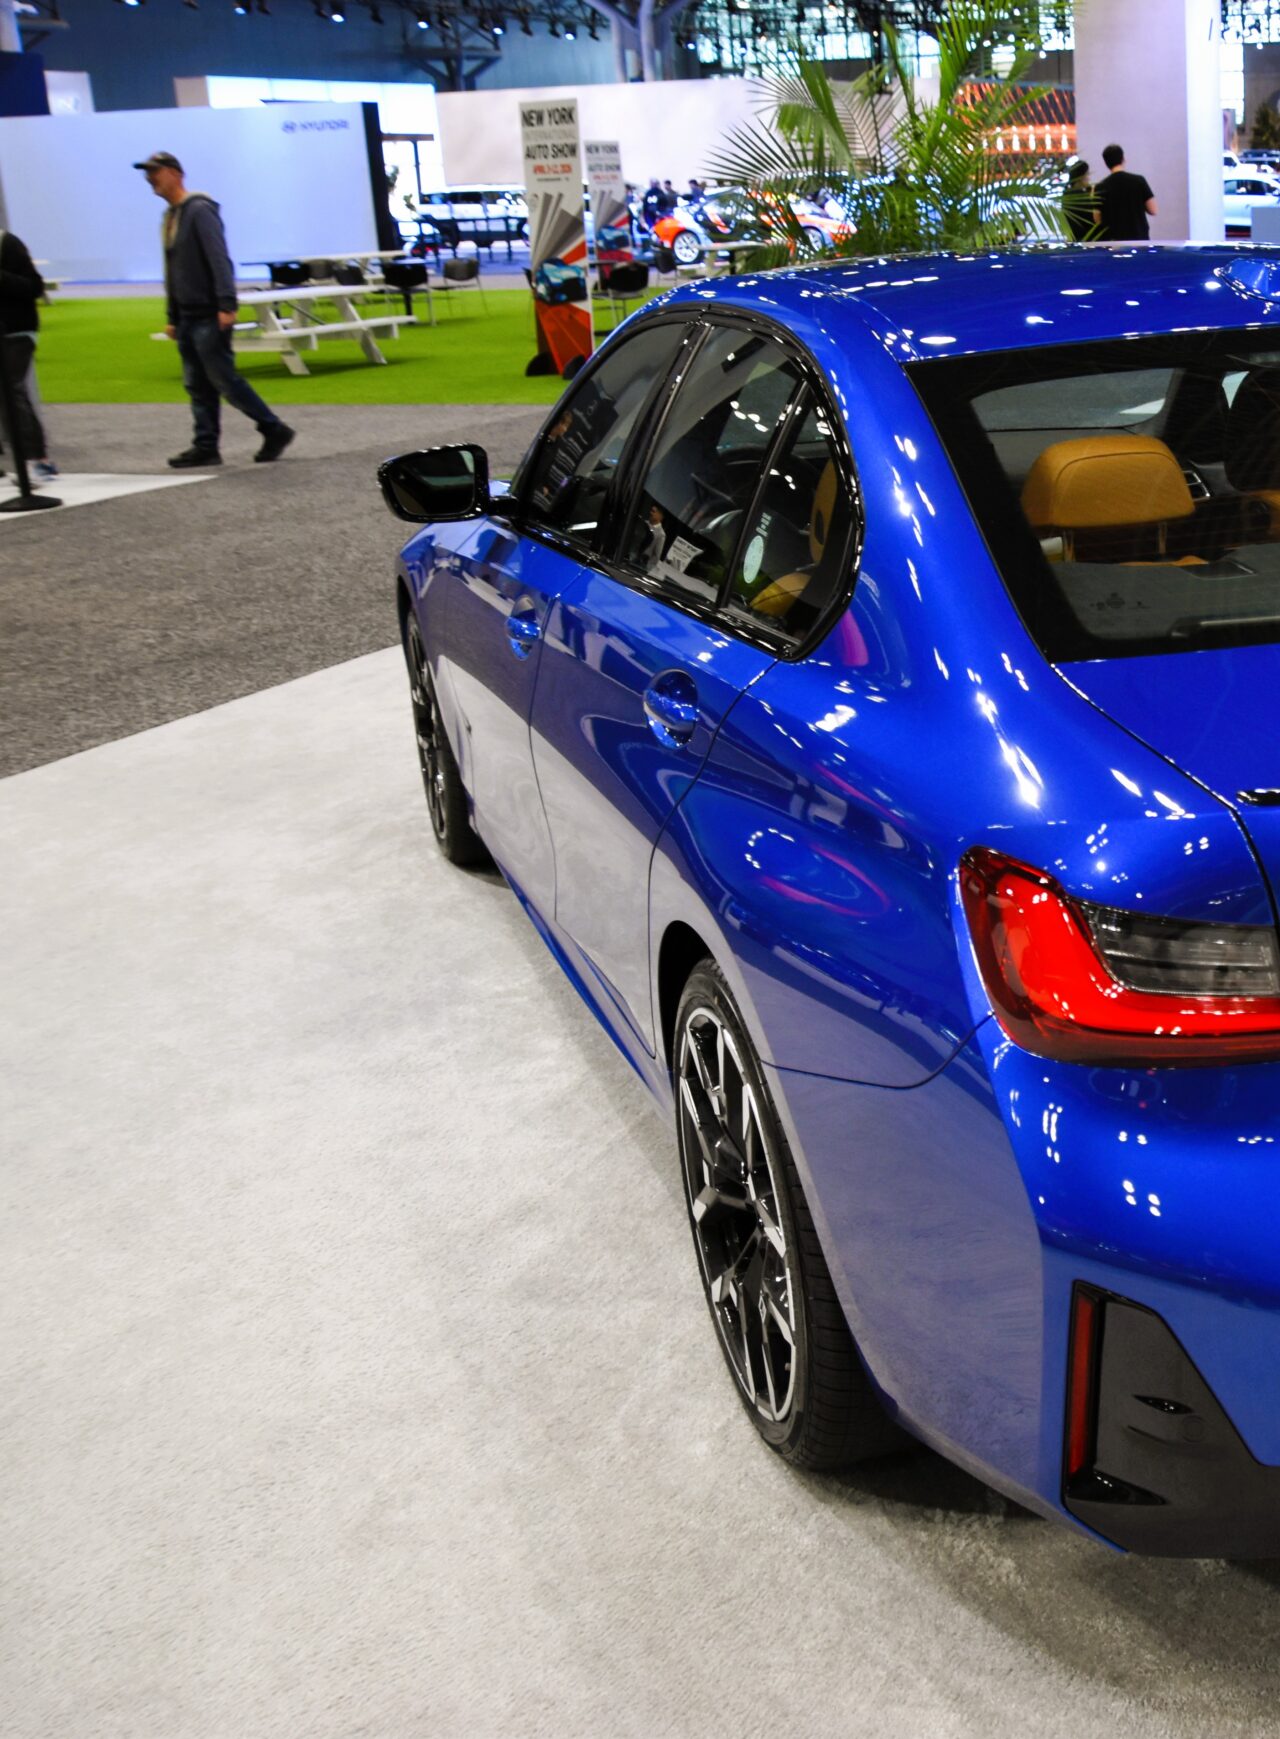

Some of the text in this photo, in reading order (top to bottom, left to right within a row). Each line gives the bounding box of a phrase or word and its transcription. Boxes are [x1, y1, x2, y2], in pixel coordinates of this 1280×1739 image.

[521, 107, 575, 127] NEW YORK
[525, 143, 577, 159] AUTO SHOW
